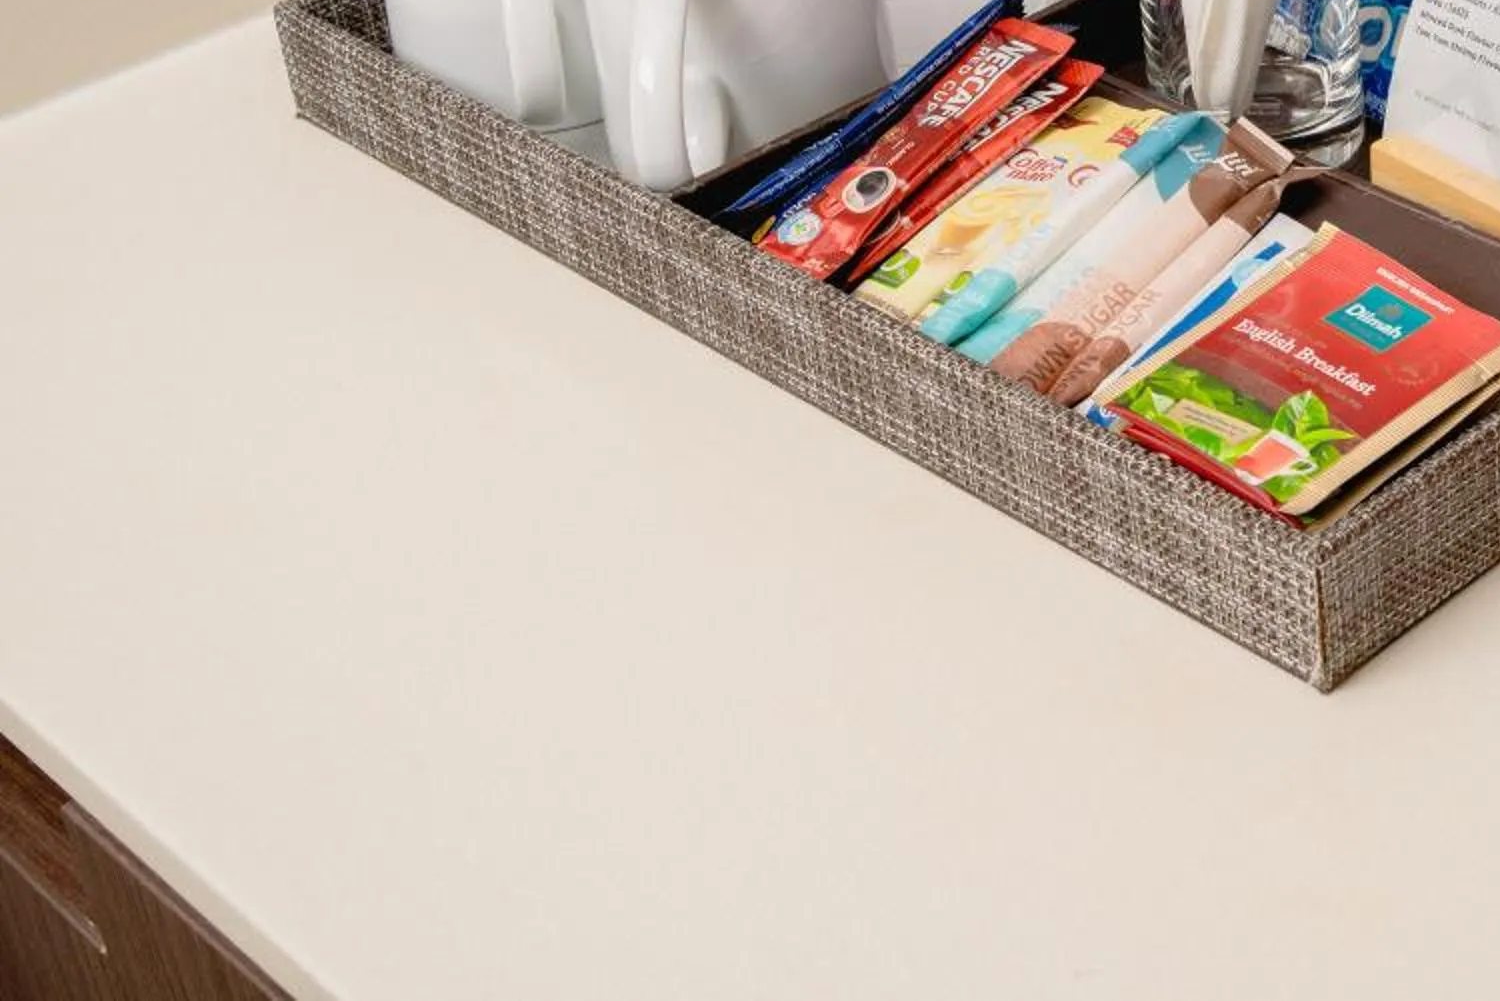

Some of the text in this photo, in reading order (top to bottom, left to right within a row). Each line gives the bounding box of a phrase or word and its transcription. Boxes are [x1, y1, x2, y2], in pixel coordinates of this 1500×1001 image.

[927, 80, 957, 112] CUP
[1062, 281, 1138, 351] SUGAR
[1344, 302, 1403, 340] Dilmah
[1232, 318, 1297, 355] English
[1293, 346, 1376, 396] Breakfast
